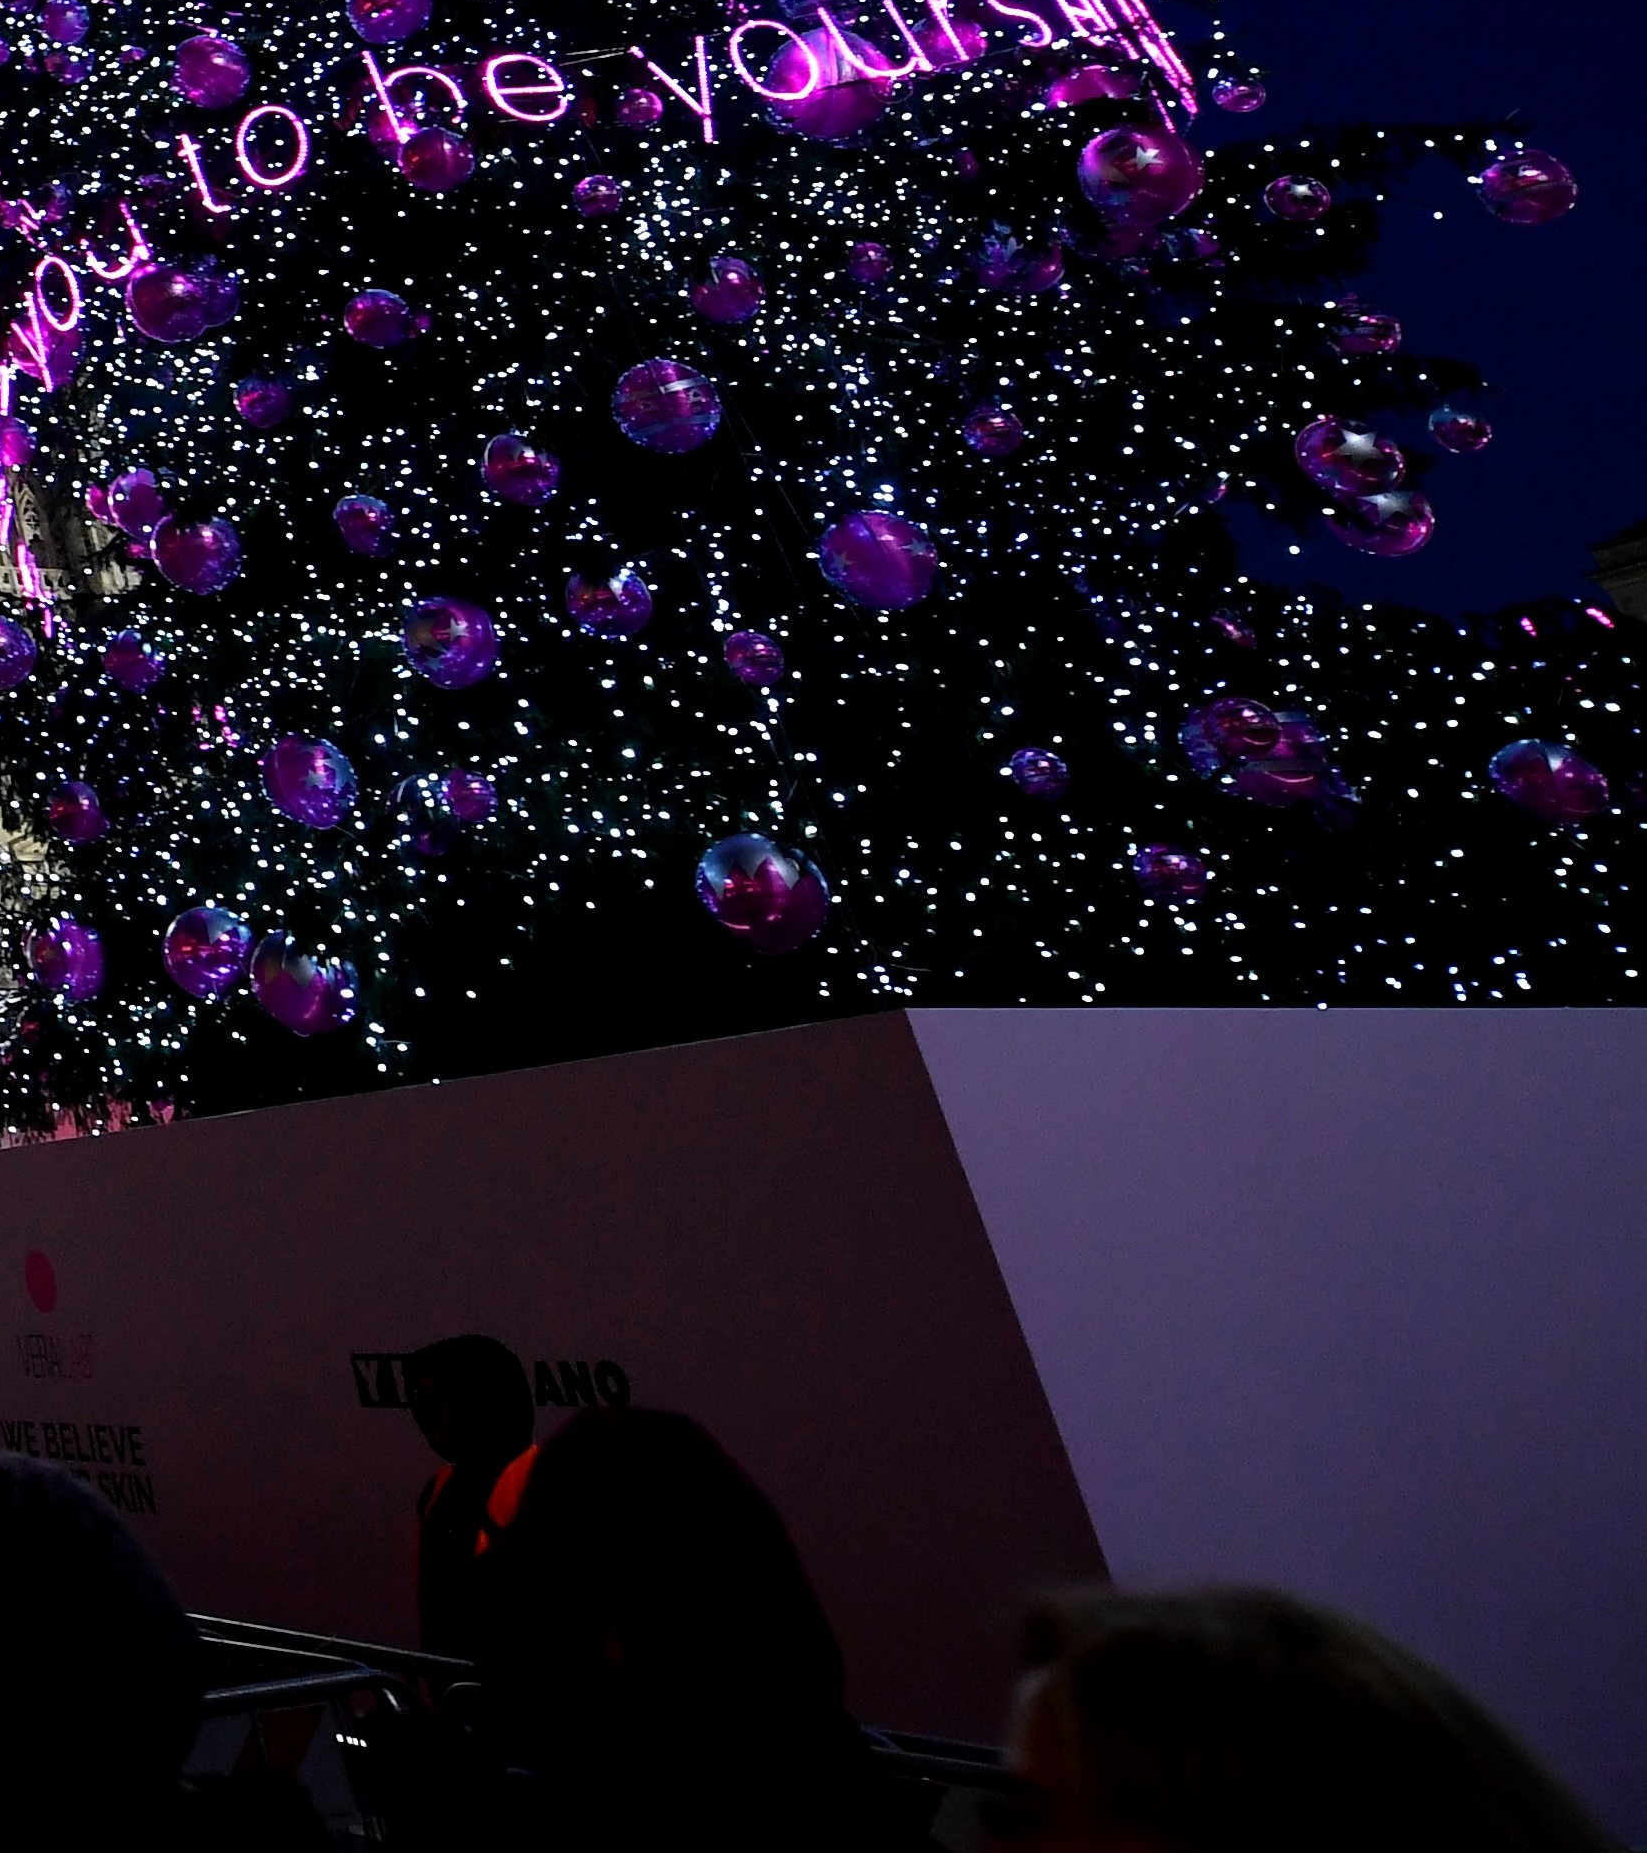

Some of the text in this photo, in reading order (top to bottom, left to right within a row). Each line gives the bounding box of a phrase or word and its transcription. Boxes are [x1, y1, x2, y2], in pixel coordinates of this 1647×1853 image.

[177, 104, 309, 213] to
[0, 1420, 148, 1467] WE BELIEVE
[97, 1470, 158, 1516] SKIN
